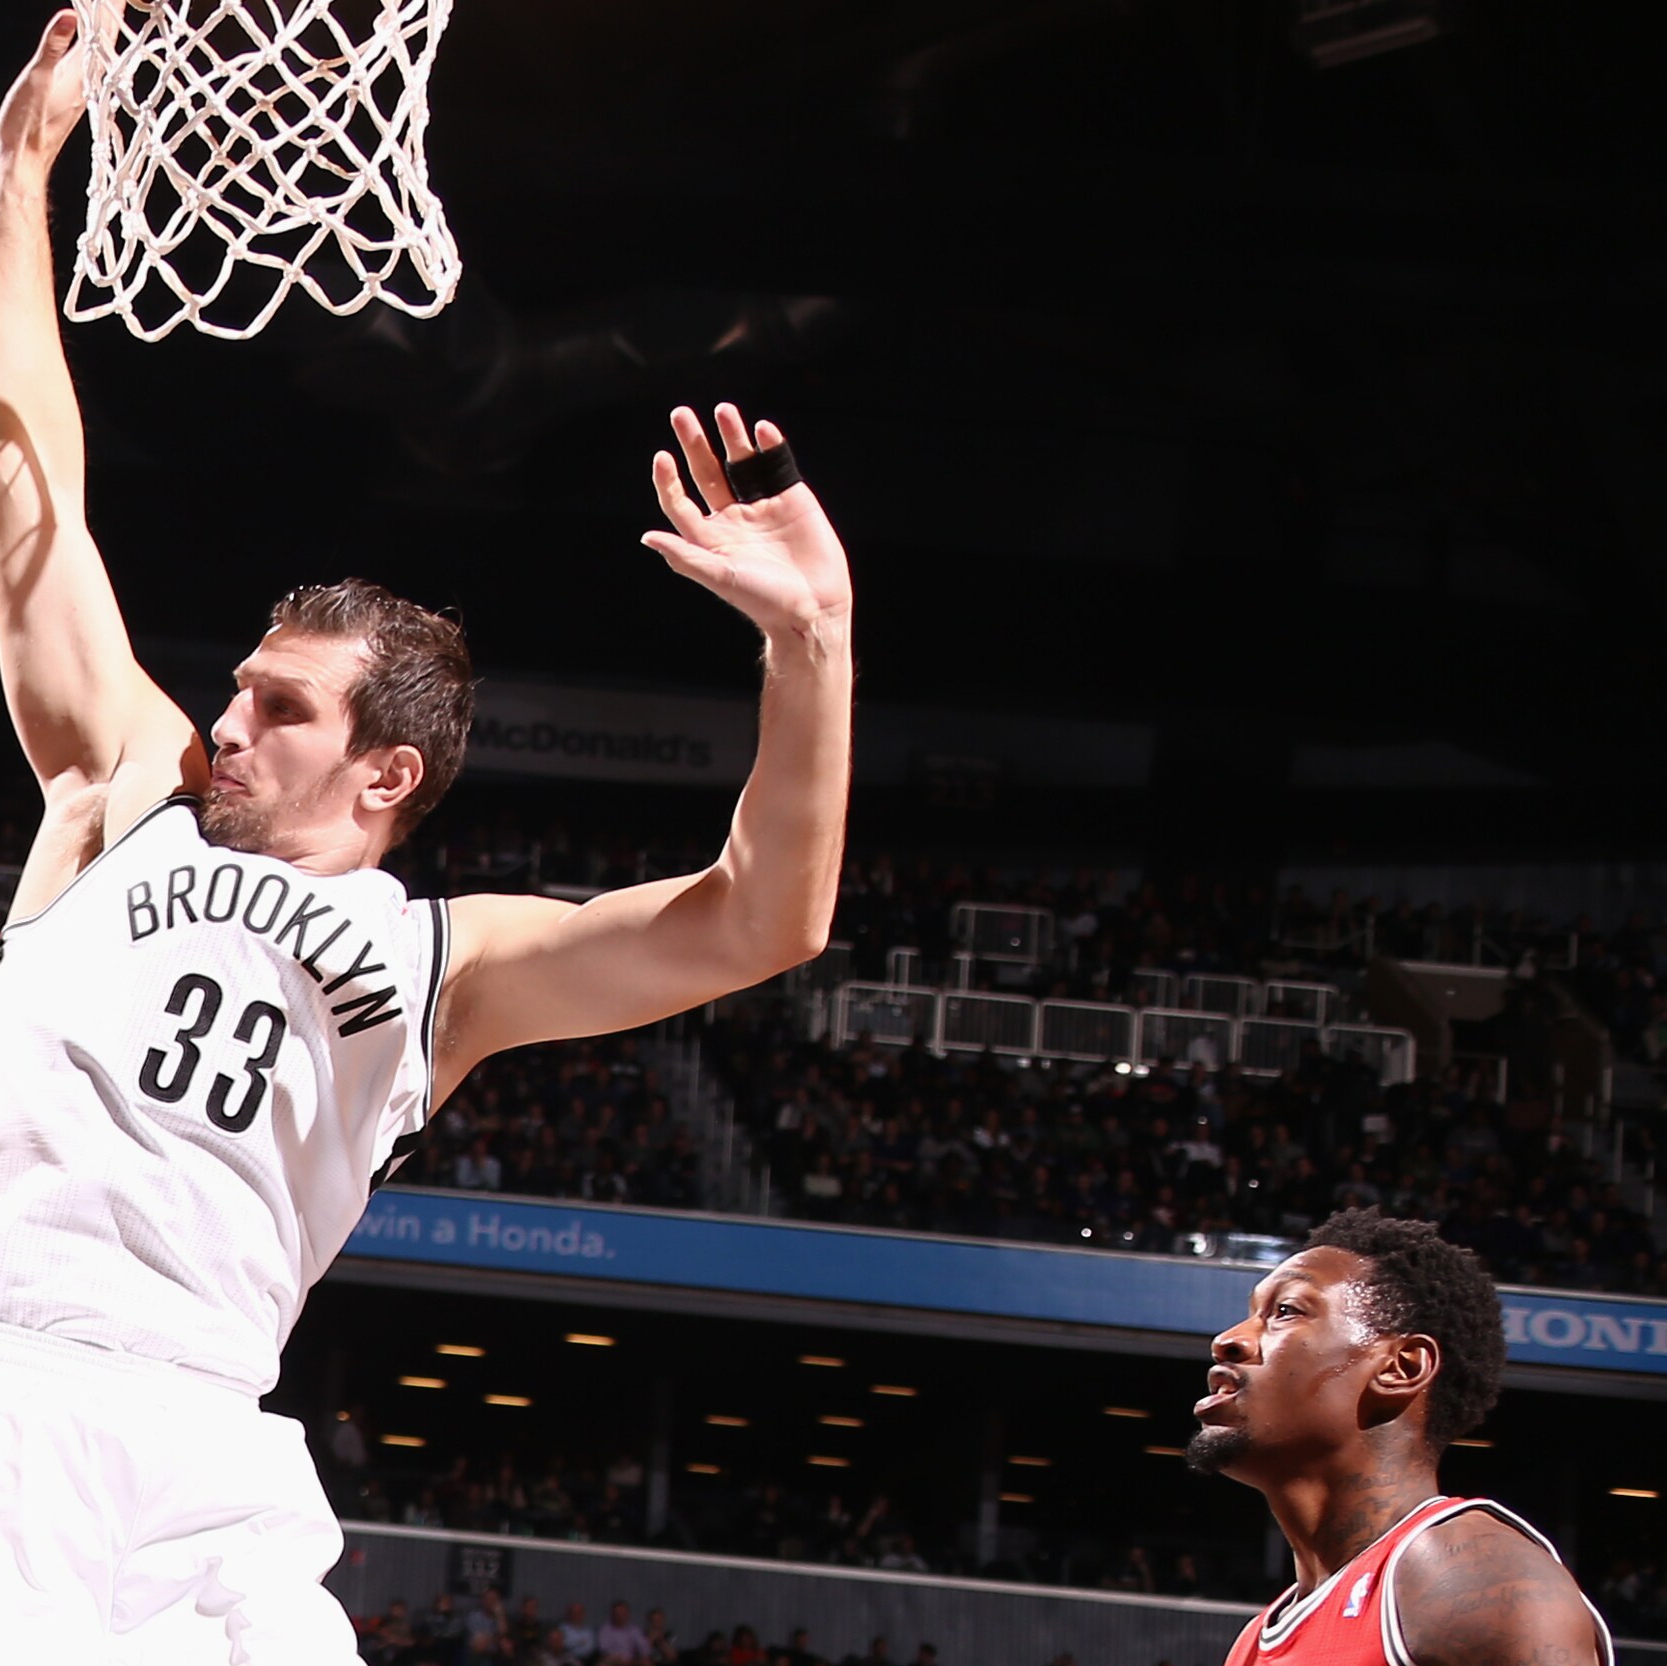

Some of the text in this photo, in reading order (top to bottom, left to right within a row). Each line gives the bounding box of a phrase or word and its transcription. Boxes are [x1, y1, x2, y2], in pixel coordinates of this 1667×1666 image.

[473, 717, 711, 768] McDonald's
[127, 864, 403, 1038] BROOKLYN
[138, 973, 286, 1134] 33
[431, 1216, 455, 1246] a
[469, 1211, 617, 1260] Honda.
